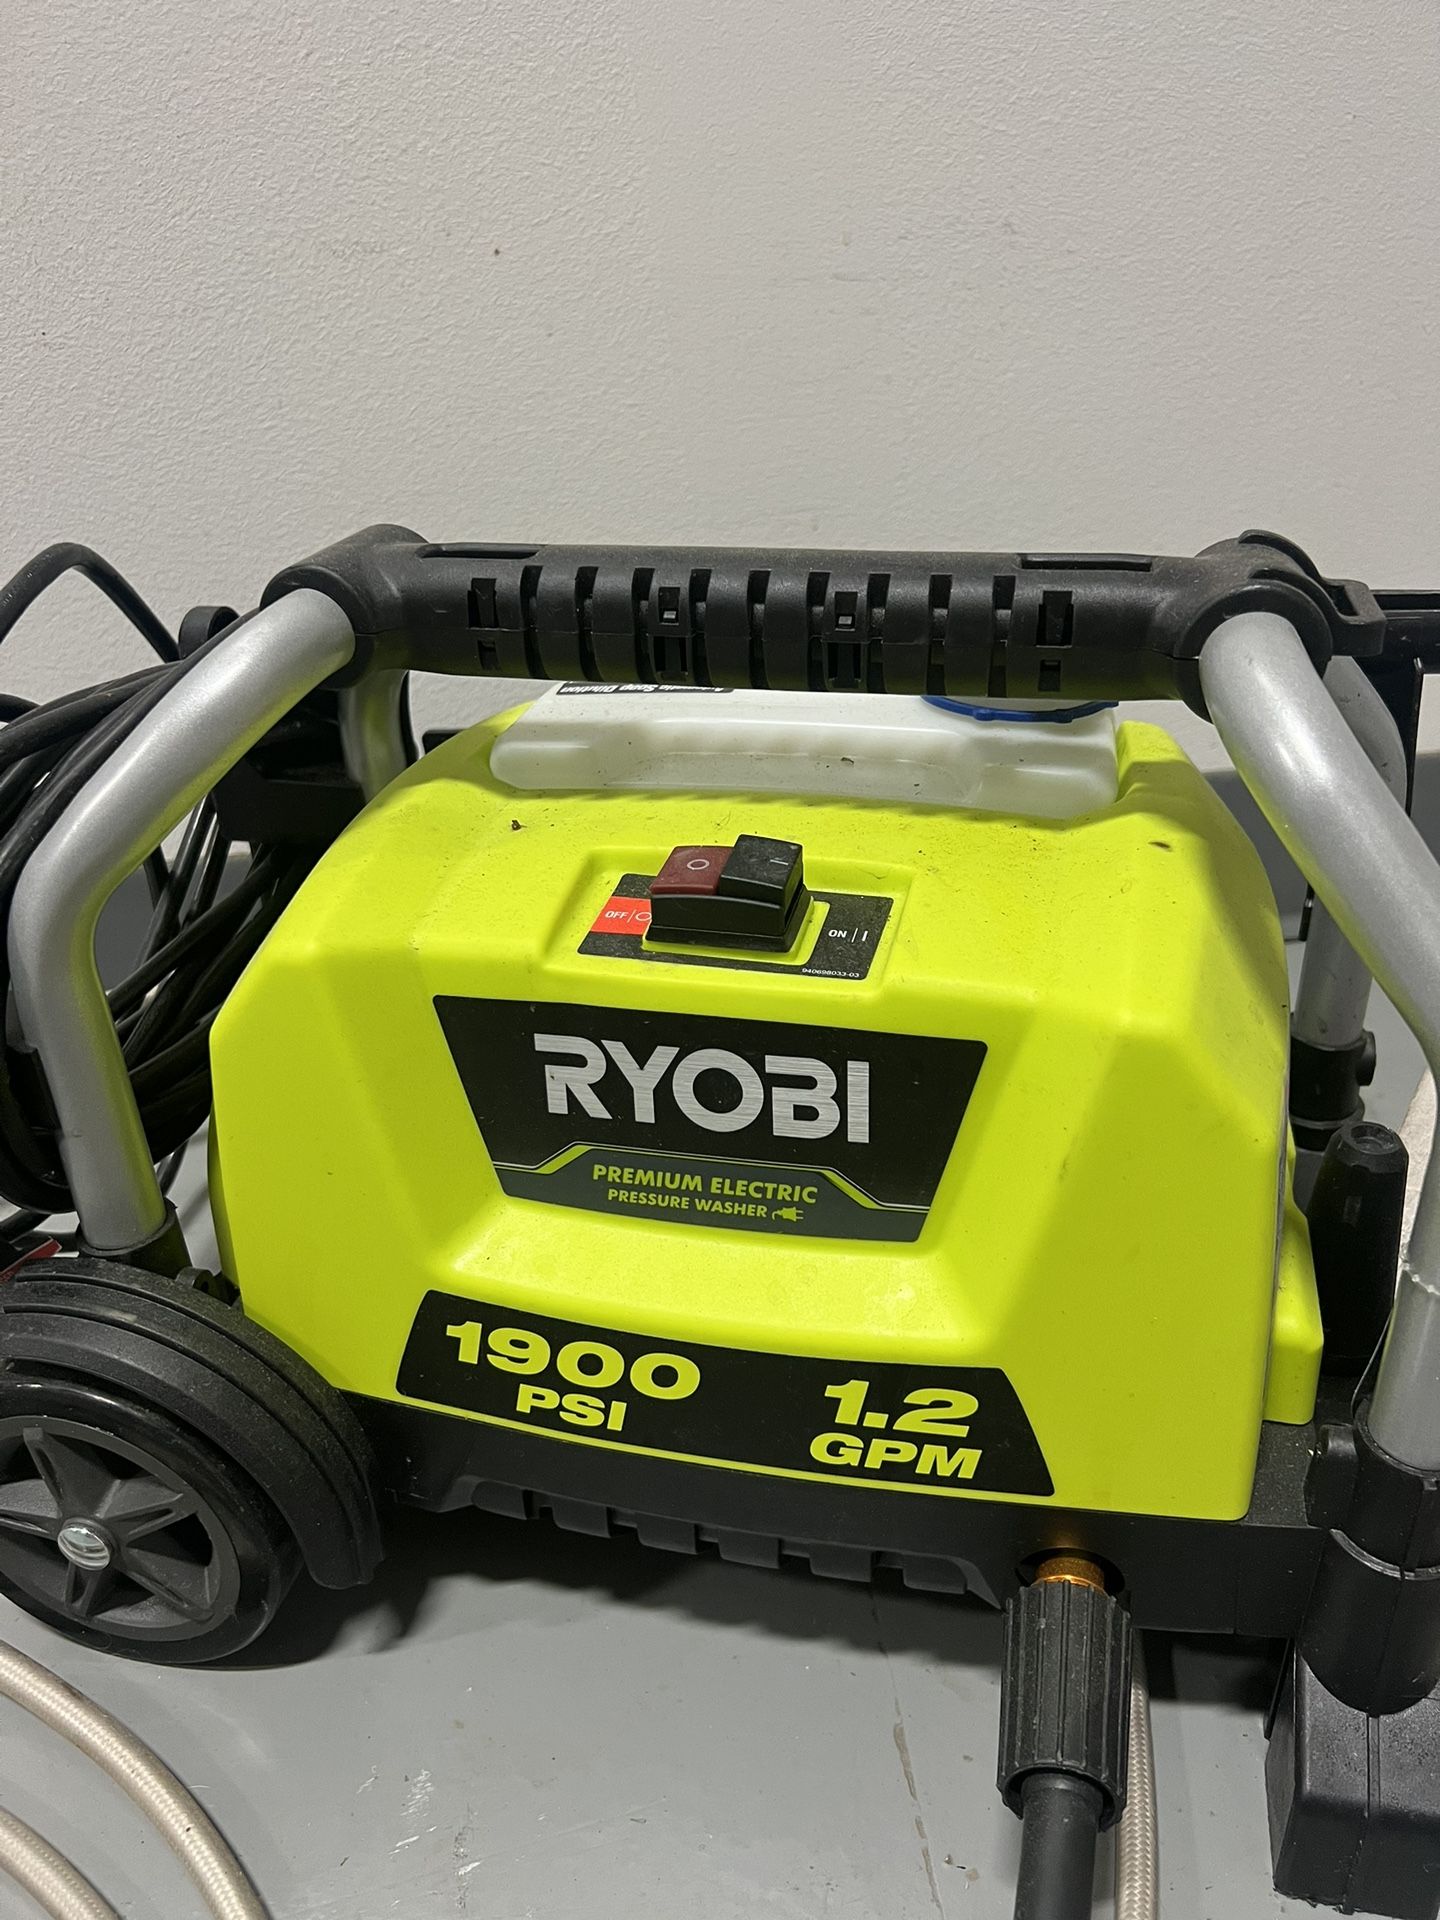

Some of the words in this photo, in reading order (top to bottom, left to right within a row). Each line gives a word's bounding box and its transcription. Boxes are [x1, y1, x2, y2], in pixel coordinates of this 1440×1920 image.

[560, 685, 619, 693] Dilution
[619, 684, 659, 692] Soap
[604, 910, 629, 919] OFF
[828, 929, 848, 939] ON
[533, 1032, 870, 1144] RYOBI
[592, 1164, 703, 1192] PREMIUM
[710, 1177, 819, 1203] ELECTRIC
[607, 1188, 690, 1210] PRESSURE
[694, 1198, 768, 1218] WASHER
[446, 1320, 701, 1401] 1900
[515, 1383, 628, 1432] PSI
[824, 1379, 979, 1438] 1.2
[809, 1432, 983, 1479] GPM
